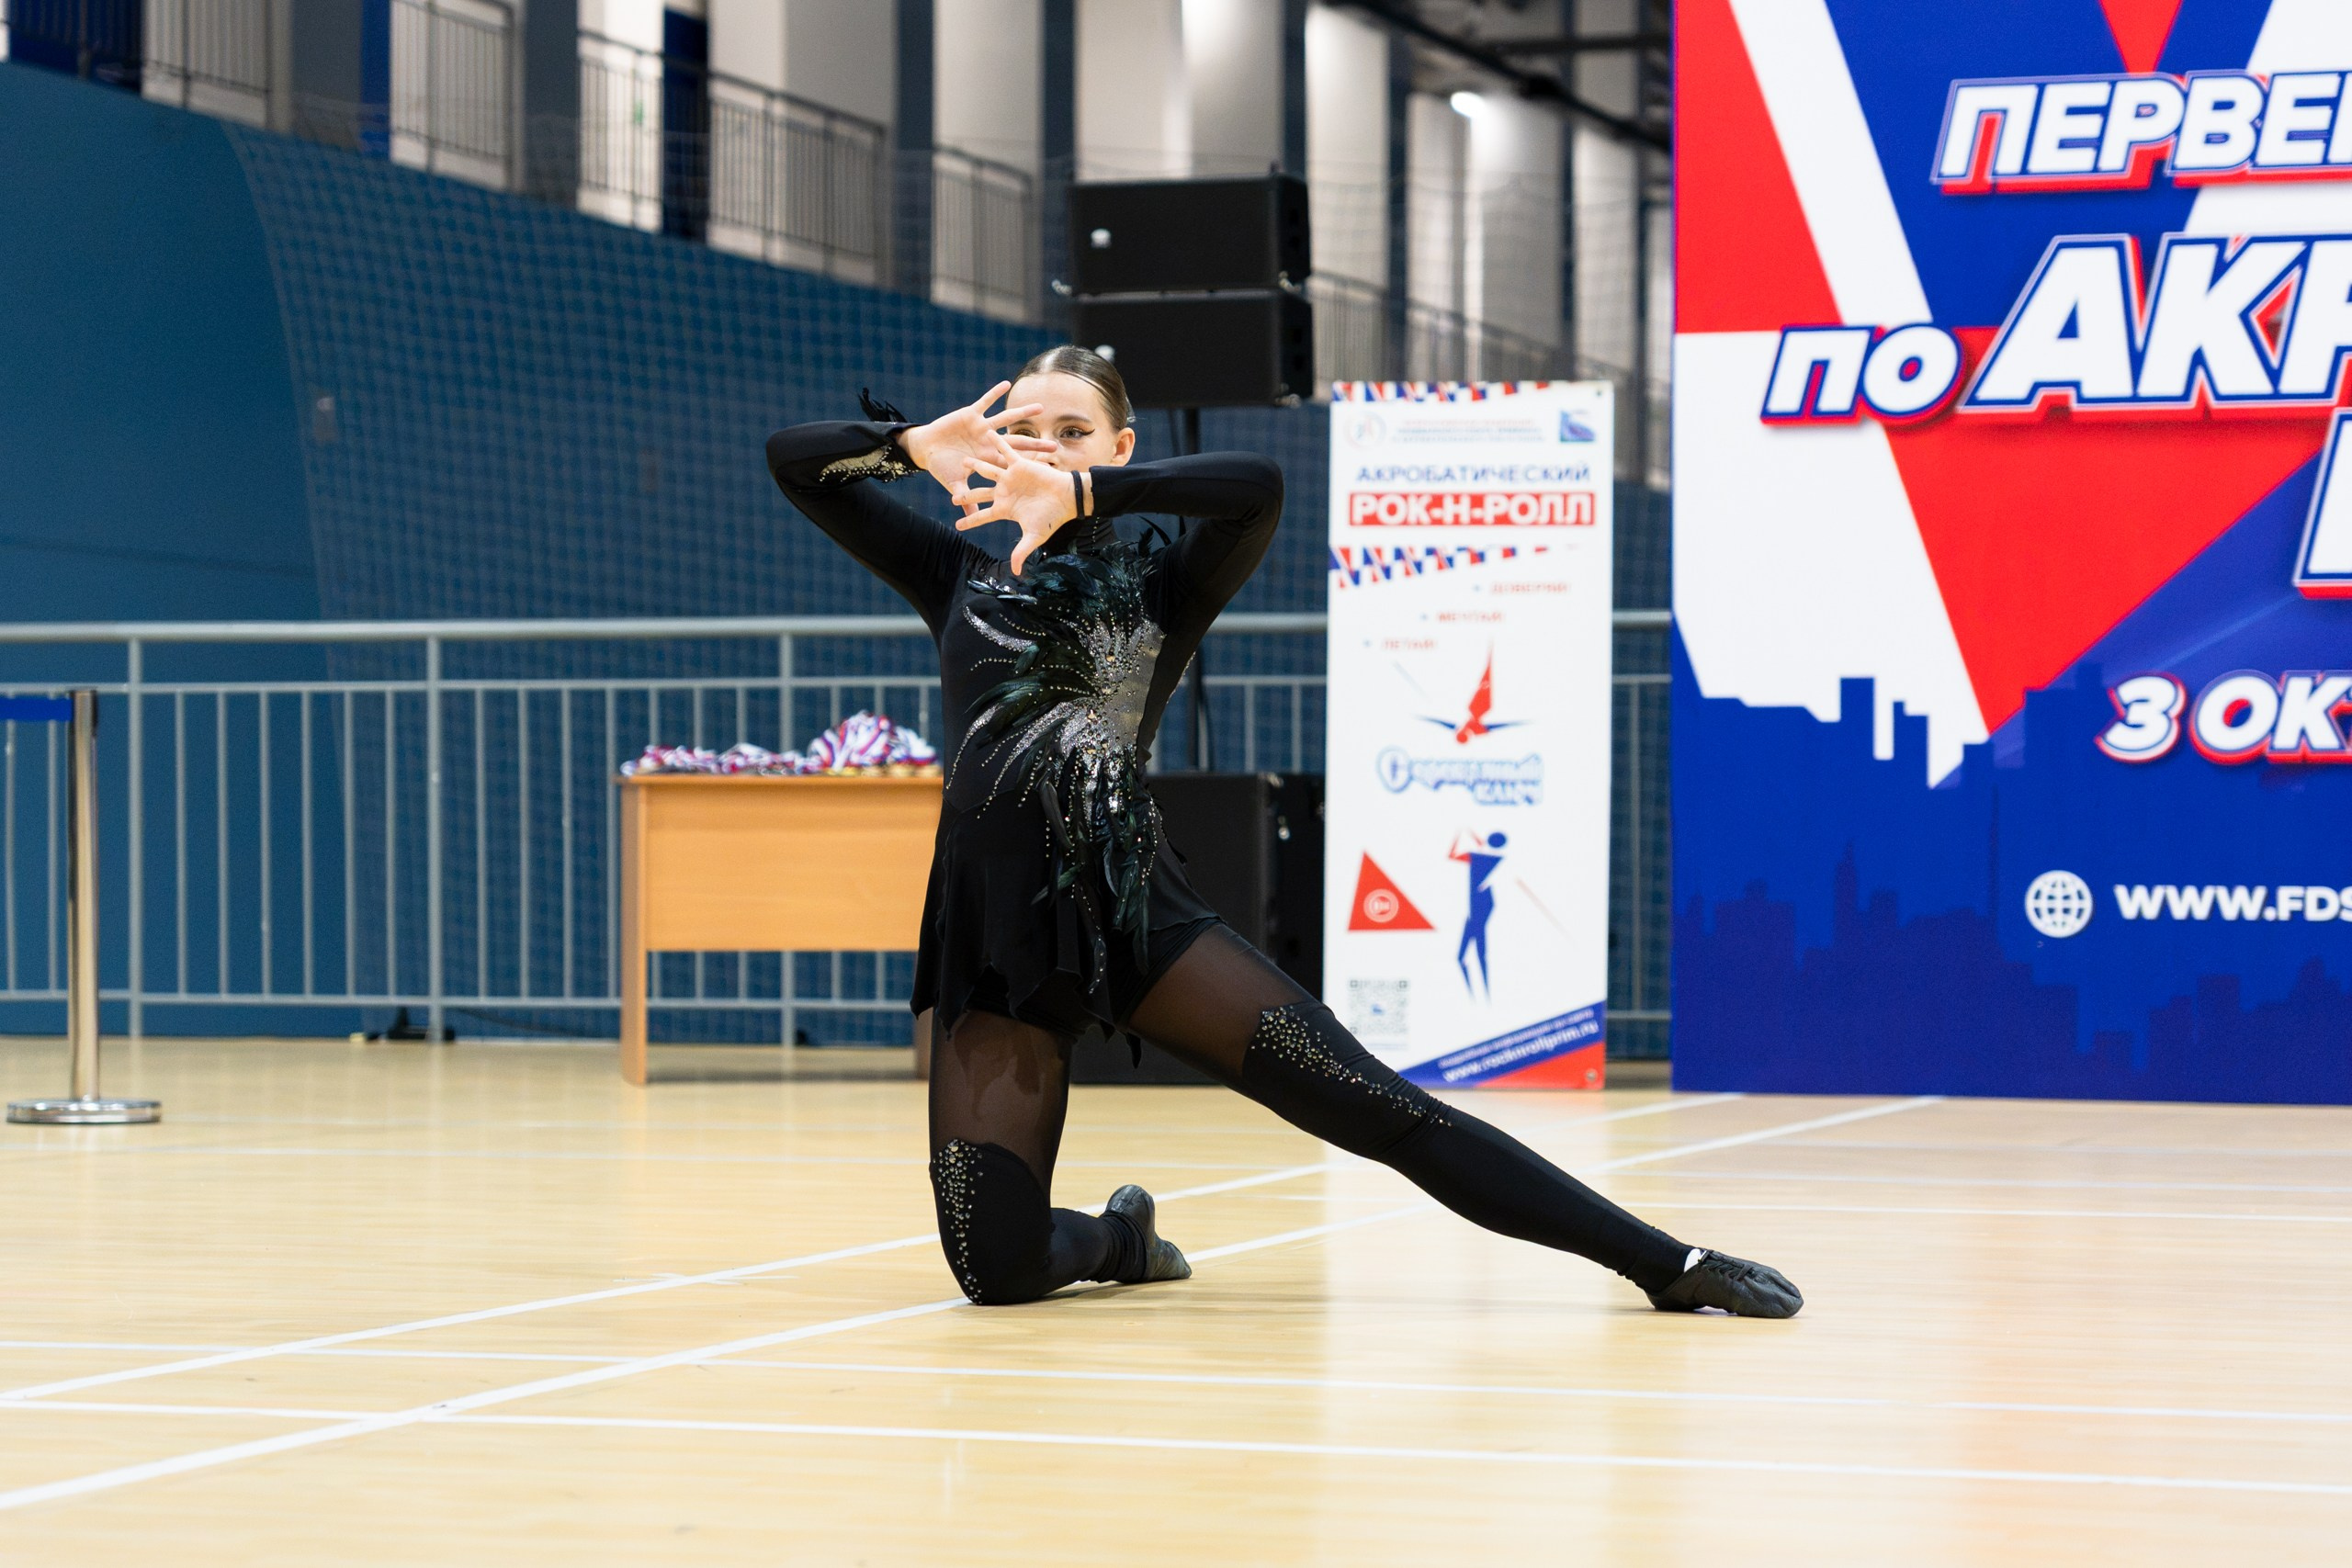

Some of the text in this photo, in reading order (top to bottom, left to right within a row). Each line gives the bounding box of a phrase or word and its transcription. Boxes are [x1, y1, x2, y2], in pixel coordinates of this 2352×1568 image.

[1931, 70, 2352, 192] ПЕРВЕ
[1356, 463, 1590, 482] АКРОБАТИЧЕСКИЙ
[1351, 493, 1591, 525] РОК-Н-РОЛЛ
[2095, 670, 2352, 764] 3 ОК
